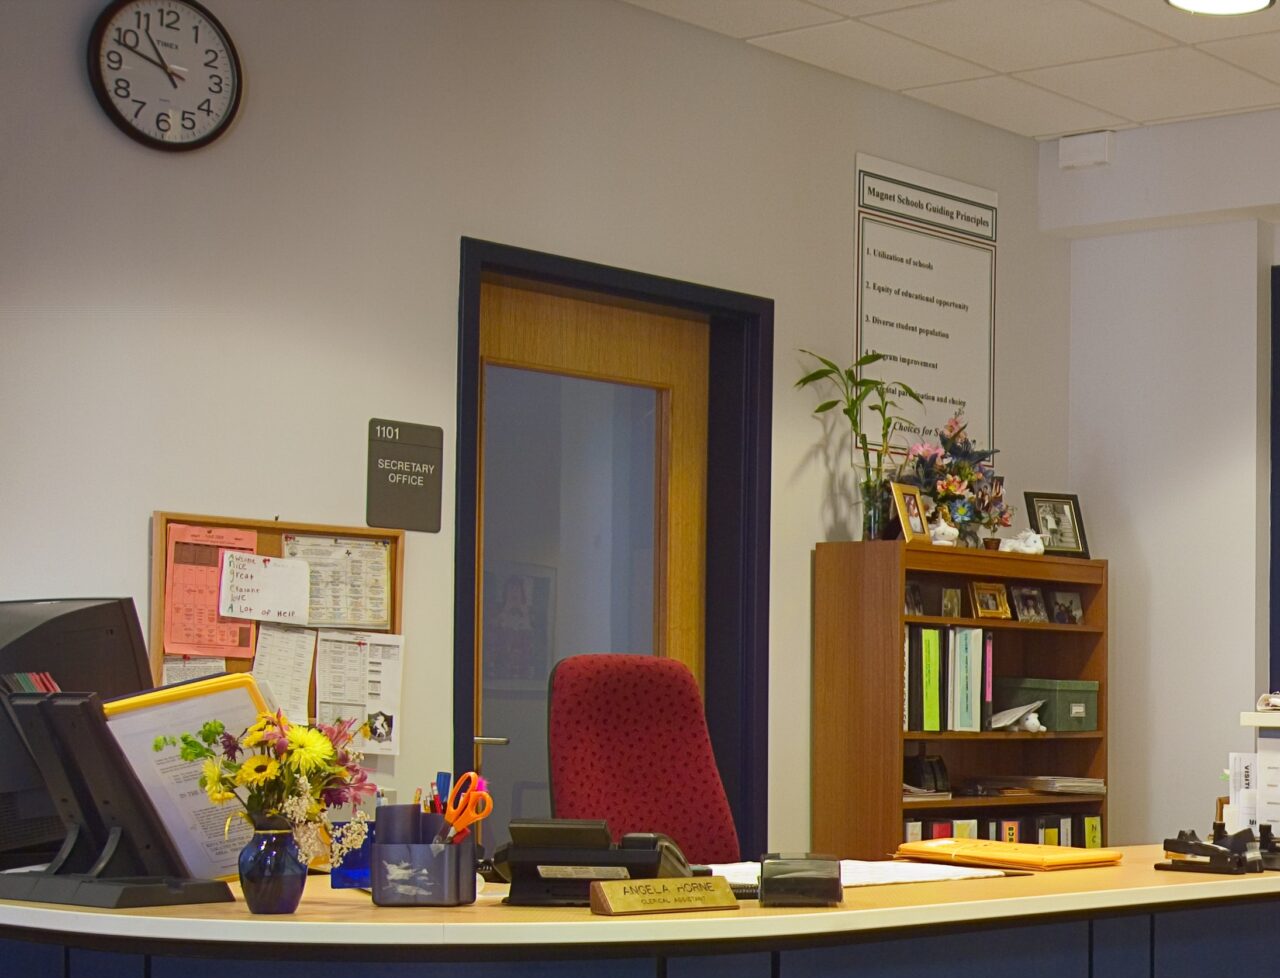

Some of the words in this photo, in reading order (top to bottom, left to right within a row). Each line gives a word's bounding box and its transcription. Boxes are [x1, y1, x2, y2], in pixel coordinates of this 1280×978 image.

[135, 11, 151, 32] 11
[157, 8, 181, 31] 12
[115, 27, 140, 51] 10
[192, 25, 199, 44] 1
[155, 40, 179, 50] TIMEX
[106, 50, 123, 71] 9
[203, 49, 219, 70] 2
[114, 78, 131, 99] 8
[208, 74, 223, 94] 3
[131, 99, 147, 118] 7
[197, 98, 214, 117] 4
[155, 112, 171, 132] 6
[181, 110, 196, 130] 5
[867, 186, 896, 202] Magnet
[897, 194, 924, 210] Schools
[925, 203, 954, 220] Guiding
[956, 210, 989, 227] Principles
[873, 249, 904, 263] Utilization
[912, 260, 933, 270] schools
[872, 282, 892, 295] Equity
[894, 288, 901, 296] of
[901, 290, 935, 304] educational
[935, 298, 969, 312] opportunity
[872, 315, 895, 328] Diverse
[896, 322, 917, 332] student
[918, 325, 949, 339] population
[899, 356, 938, 369] improvement
[936, 395, 947, 403] and
[375, 425, 399, 440] 1101
[893, 421, 920, 434] Choices
[922, 426, 933, 437] for
[378, 459, 435, 474] SECRETARY
[388, 473, 424, 486] OFFICE
[228, 603, 234, 613] A
[623, 884, 669, 896] ANGELA
[677, 882, 715, 893] HORNE
